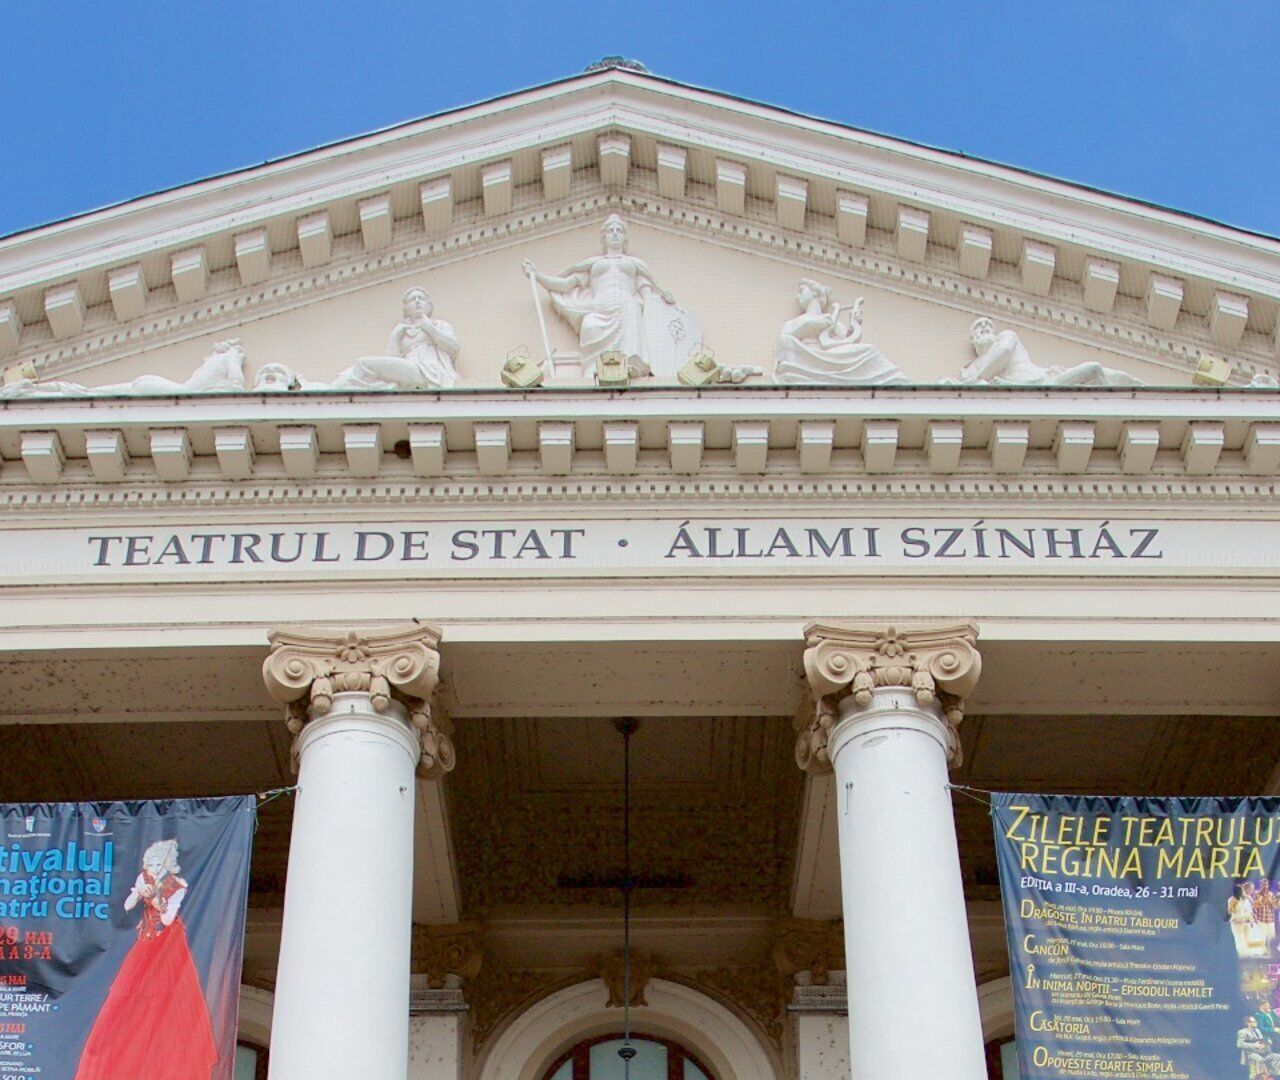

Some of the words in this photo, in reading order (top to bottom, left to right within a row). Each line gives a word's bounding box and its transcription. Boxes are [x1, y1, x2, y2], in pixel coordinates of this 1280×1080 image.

[88, 531, 341, 566] TEATRUL
[353, 530, 429, 562] DE
[450, 528, 586, 561] STAT
[664, 520, 882, 559] ÁLLAMI
[900, 519, 1163, 559] SZÍNHÁZ
[1006, 806, 1111, 846] ZILELE
[1021, 843, 1143, 879] REGINA
[1156, 846, 1265, 879] MARIA
[1055, 884, 1062, 892] a
[1064, 882, 1090, 896] III-a,
[1091, 884, 1133, 899] Oradea,
[1135, 886, 1150, 898] 26
[1159, 886, 1174, 898] 31
[1177, 886, 1198, 898] mai
[55, 896, 110, 919] Circ
[1021, 899, 1077, 924] DRAGOSTE,
[1095, 914, 1127, 927] PATRU
[1131, 917, 1179, 929] TABLOURI
[24, 931, 54, 945] MAI
[9, 947, 20, 959] A
[23, 946, 52, 960] 3-A
[15, 993, 44, 1002] TERRE
[1042, 979, 1073, 991] INIMA
[1121, 985, 1171, 997] EPISODUL
[1172, 987, 1214, 998] HAMLET
[1094, 1060, 1134, 1072] FOARTE
[1135, 1060, 1173, 1073] SIMPLĂ
